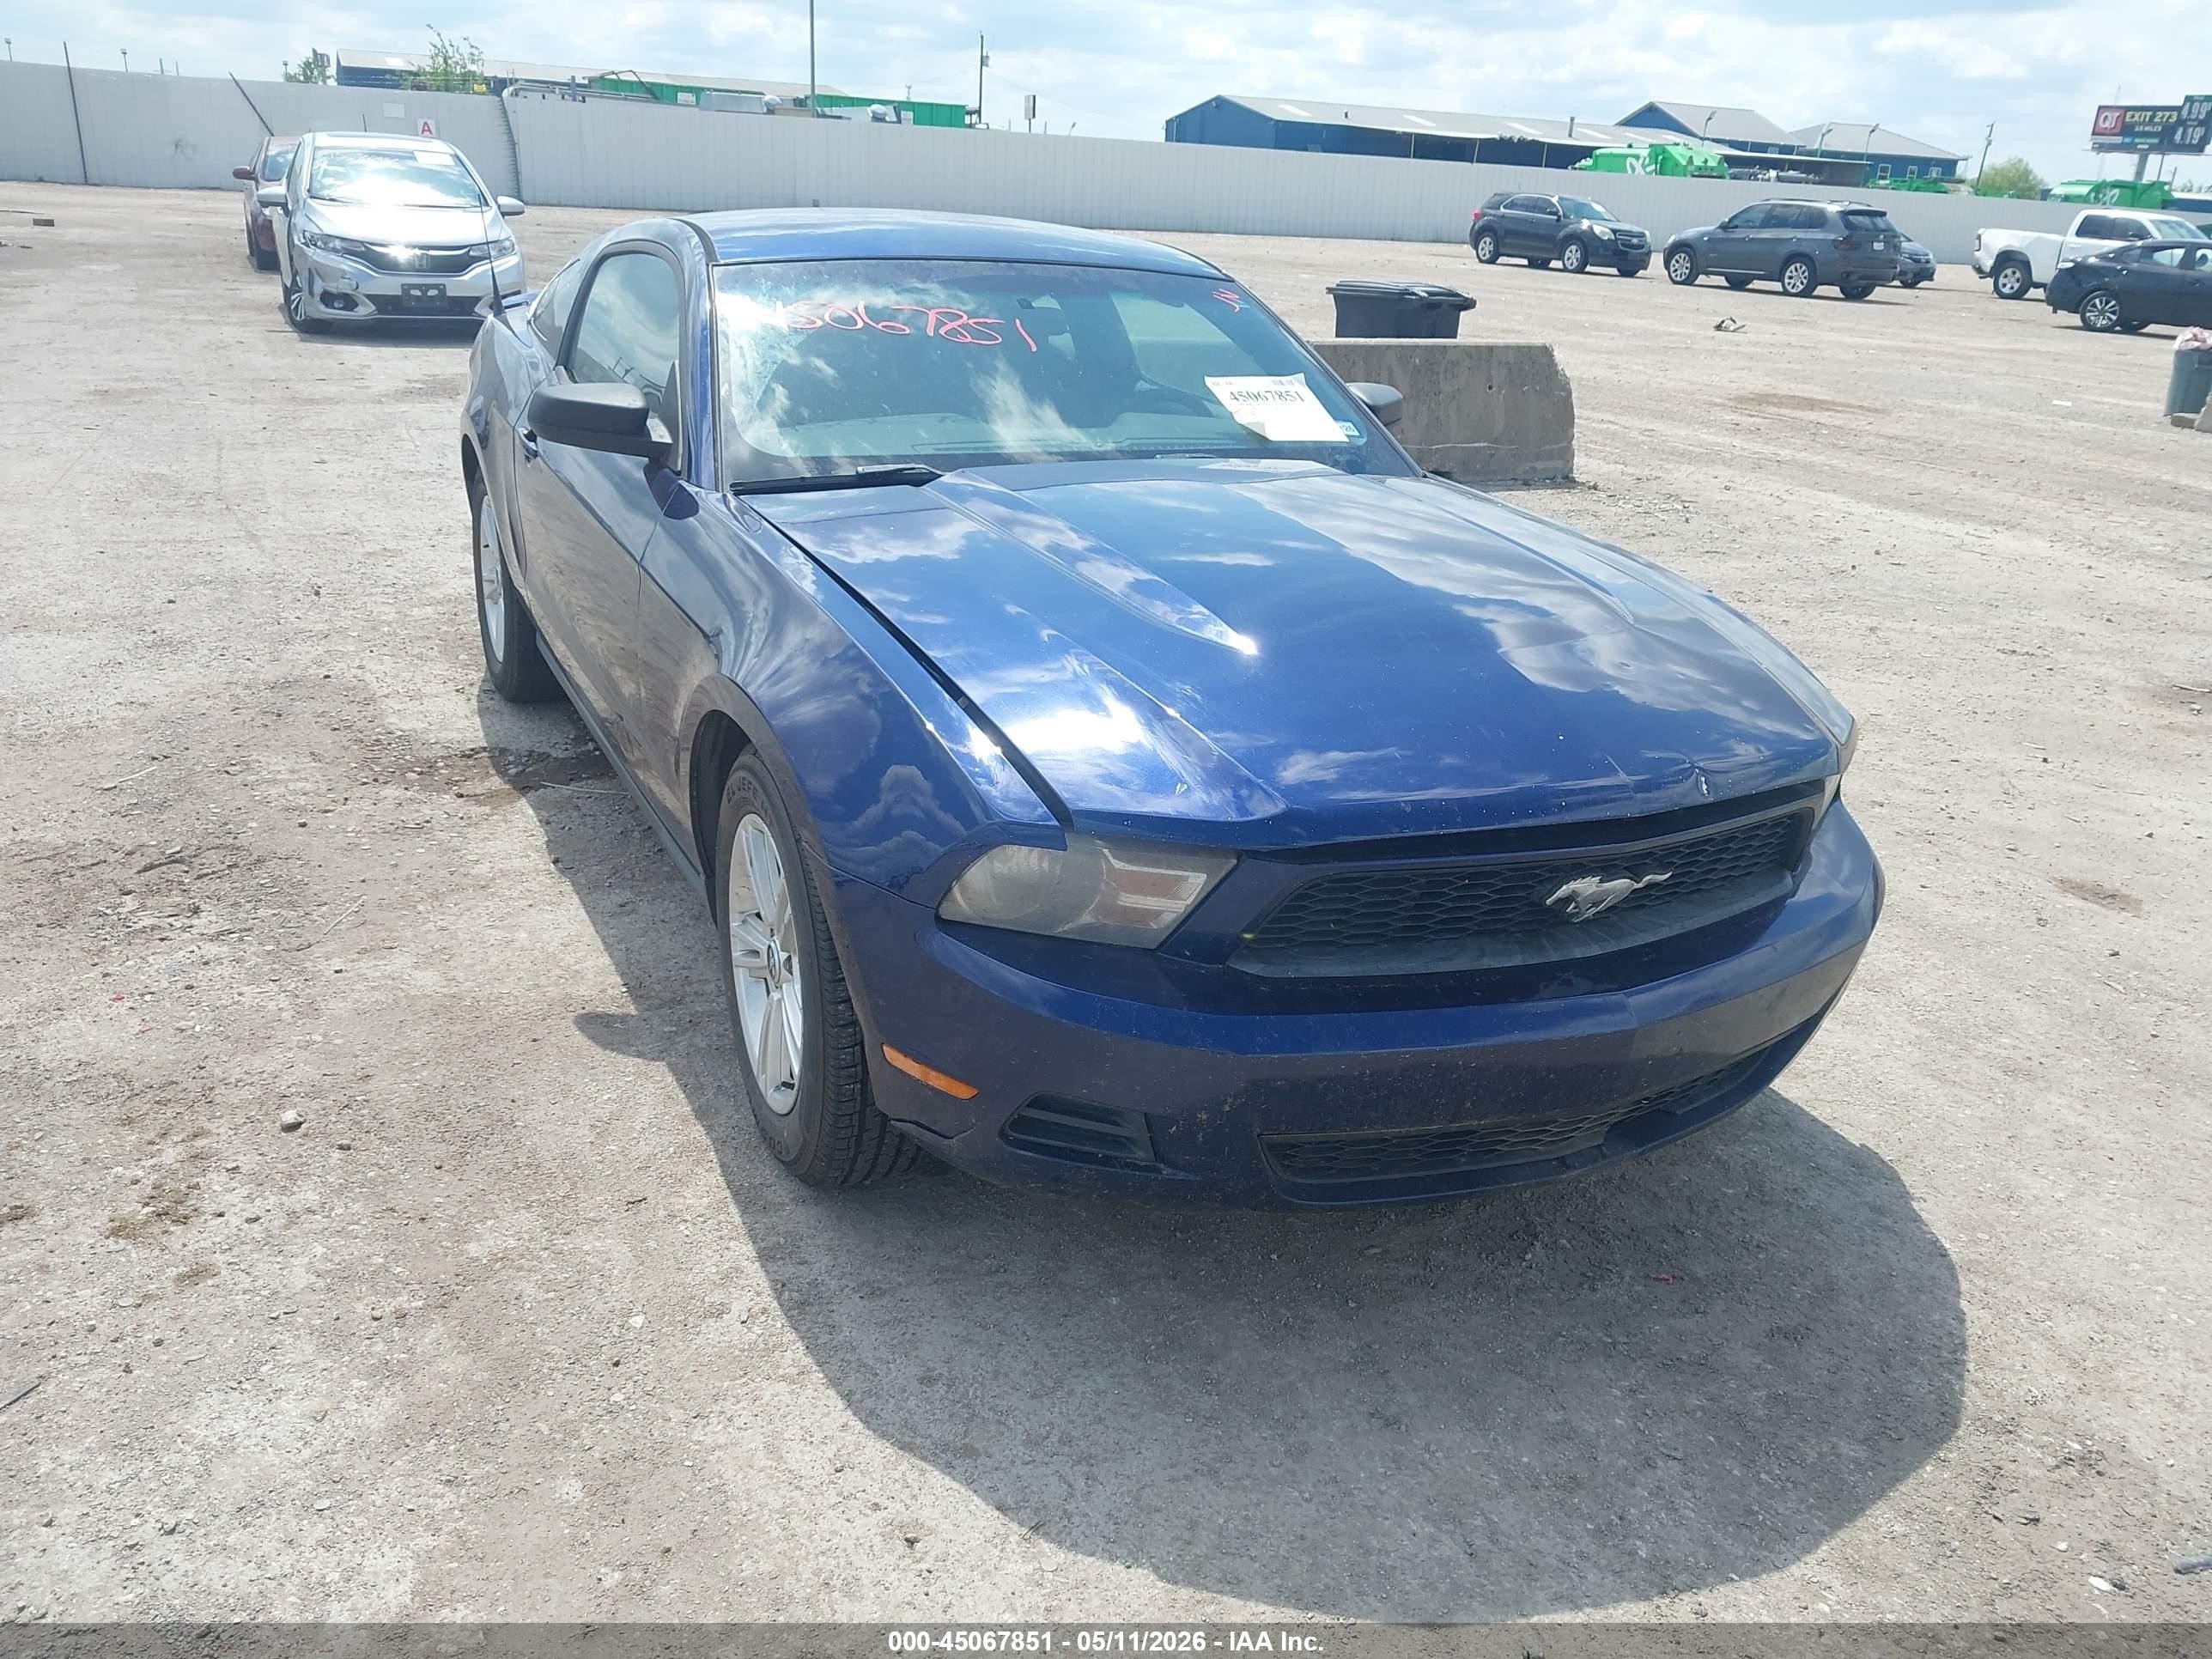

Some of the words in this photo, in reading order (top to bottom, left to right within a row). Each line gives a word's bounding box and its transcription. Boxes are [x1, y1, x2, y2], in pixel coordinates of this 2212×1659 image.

[2100, 112, 2120, 129] QT
[2125, 112, 2153, 122] EXIT
[2154, 112, 2178, 122] 273
[421, 121, 434, 135] A
[1229, 390, 1305, 403] 45067851
